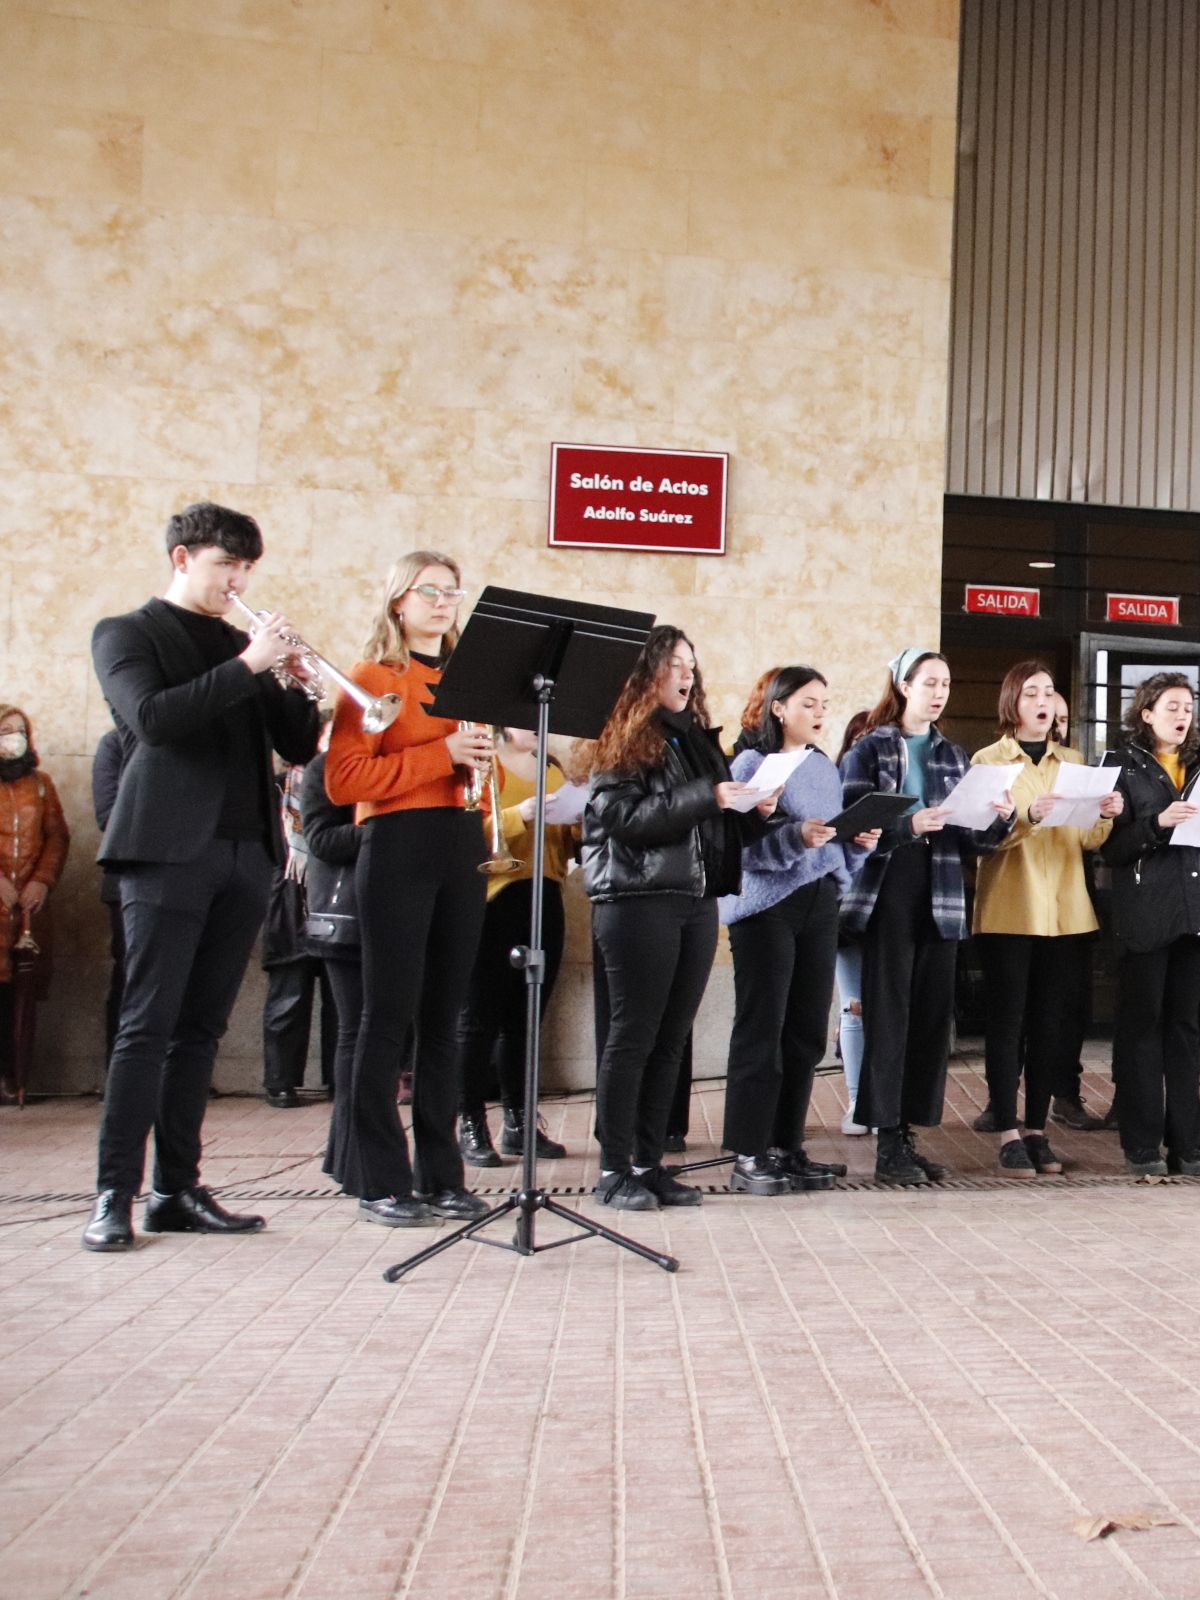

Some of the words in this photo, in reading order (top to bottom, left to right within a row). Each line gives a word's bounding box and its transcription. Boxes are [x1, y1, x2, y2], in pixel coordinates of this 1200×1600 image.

[570, 473, 624, 491] Salón
[629, 476, 654, 493] de
[658, 478, 709, 496] Actos
[583, 506, 635, 522] Adolfo
[639, 509, 693, 525] Suárez
[977, 593, 1029, 609] SALIDA
[1118, 602, 1168, 618] SALIDA
